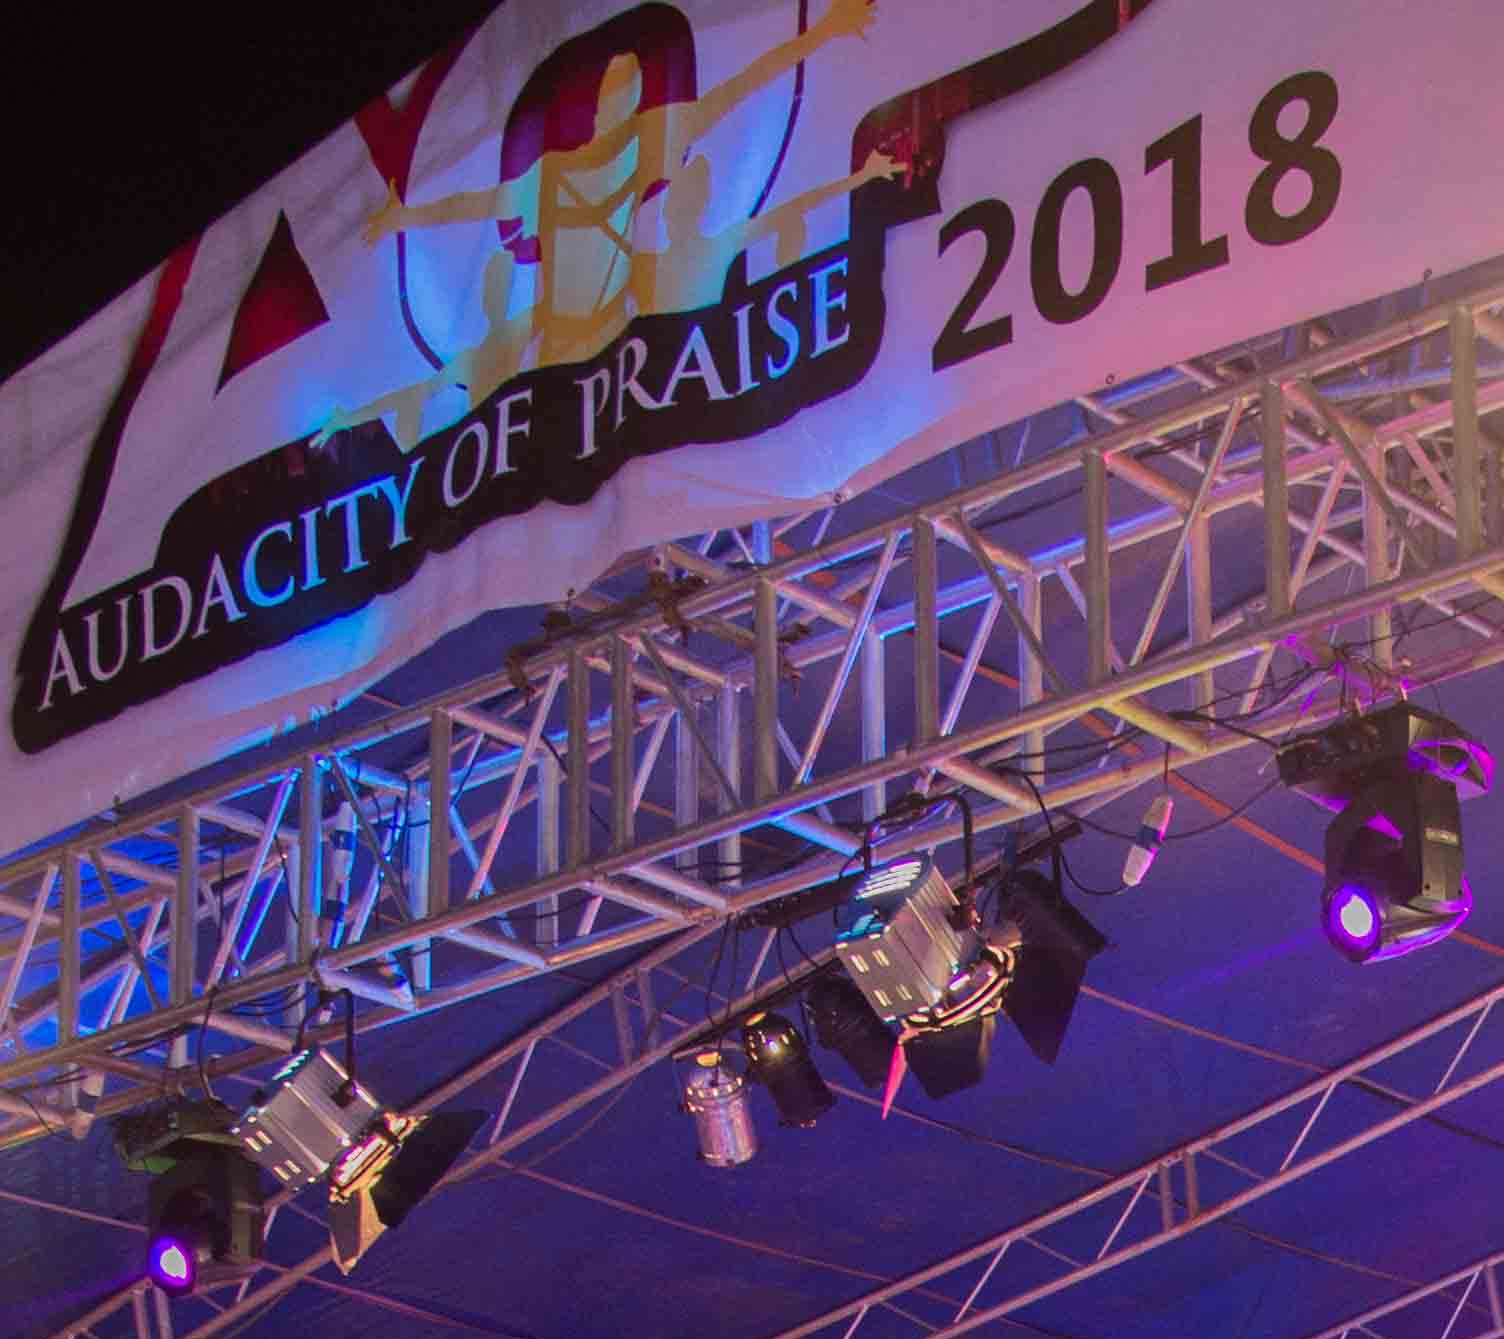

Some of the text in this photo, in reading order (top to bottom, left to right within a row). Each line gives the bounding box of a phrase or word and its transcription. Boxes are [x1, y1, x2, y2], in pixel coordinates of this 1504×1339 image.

[932, 71, 1343, 373] 2018
[37, 257, 851, 713] AUDACITY OF PRAISE
